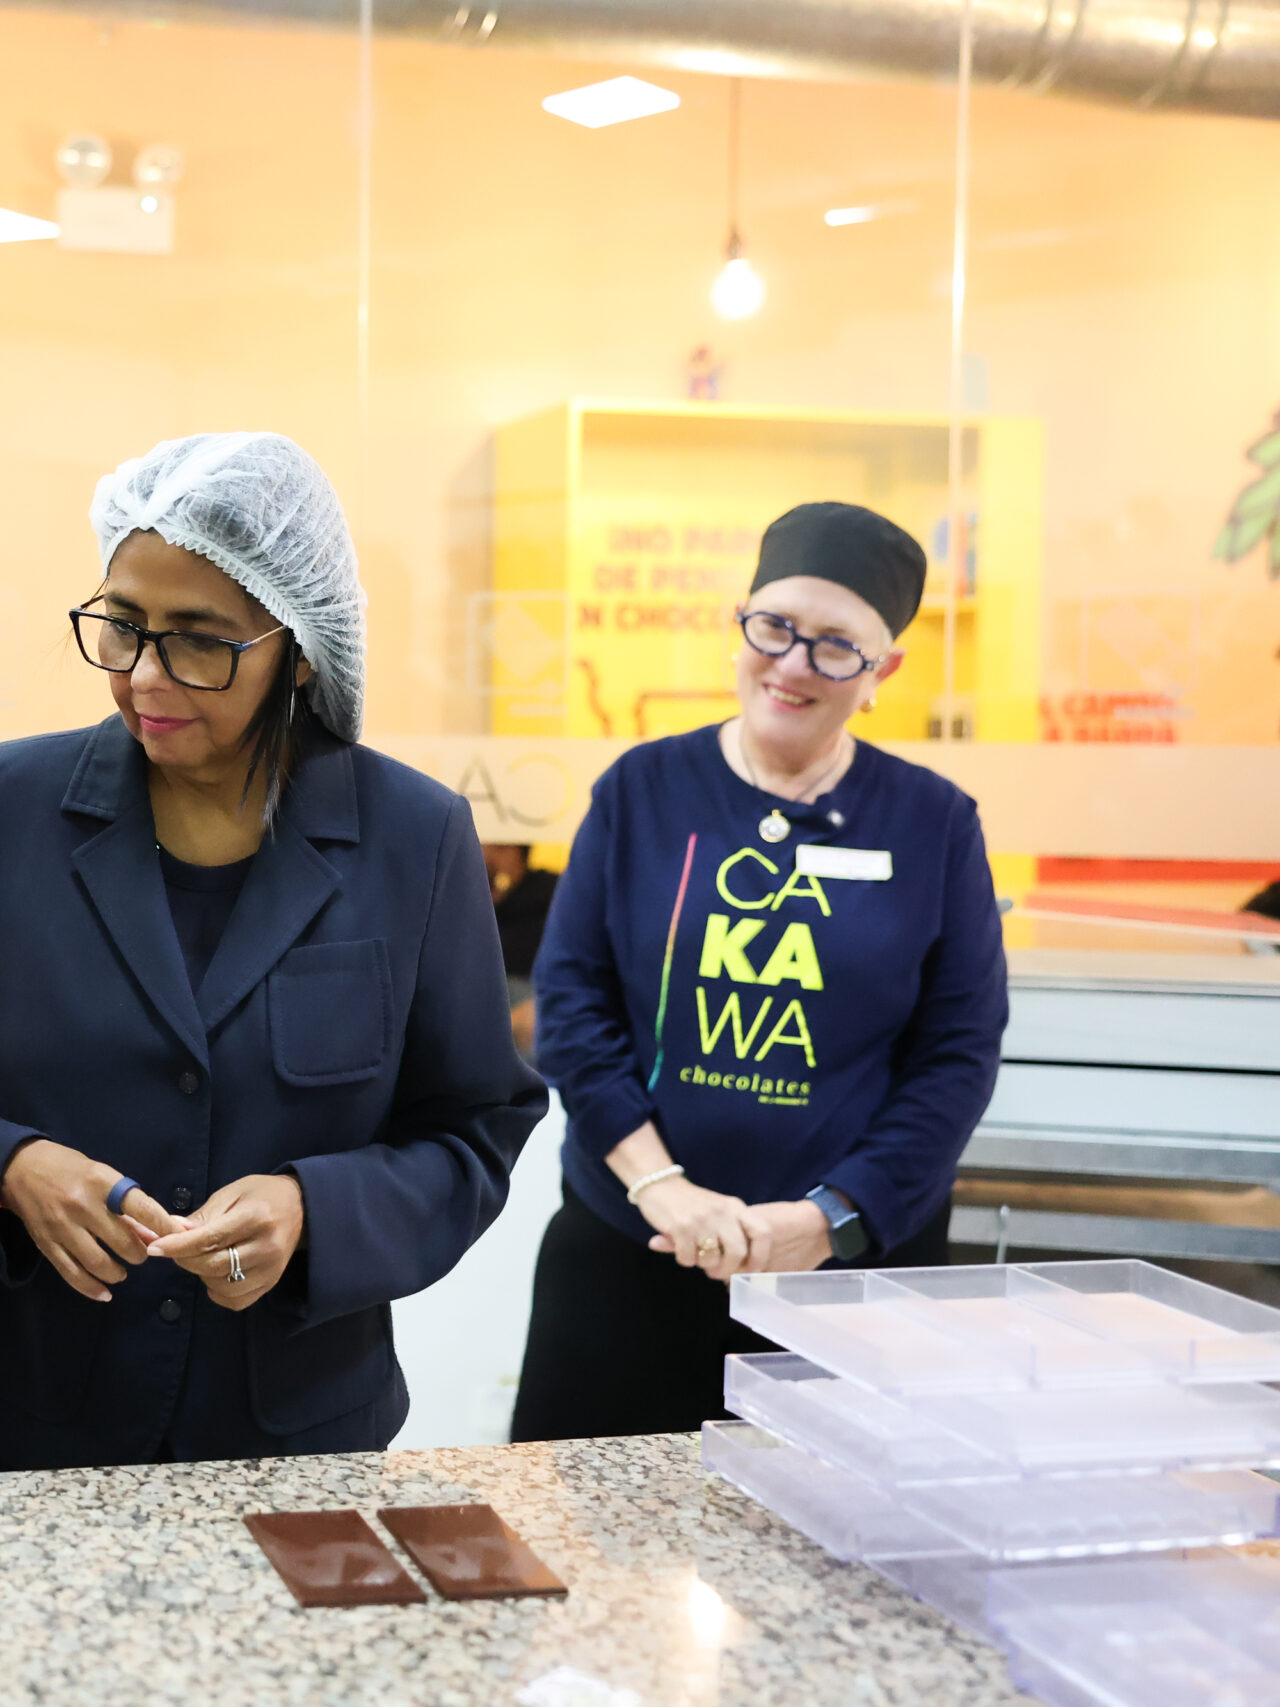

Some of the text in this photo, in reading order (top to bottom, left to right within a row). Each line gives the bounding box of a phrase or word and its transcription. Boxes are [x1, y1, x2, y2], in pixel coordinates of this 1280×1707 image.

[716, 847, 832, 917] CA
[698, 913, 824, 991] KA
[696, 986, 817, 1068] WA
[680, 1065, 811, 1095] chocolates
